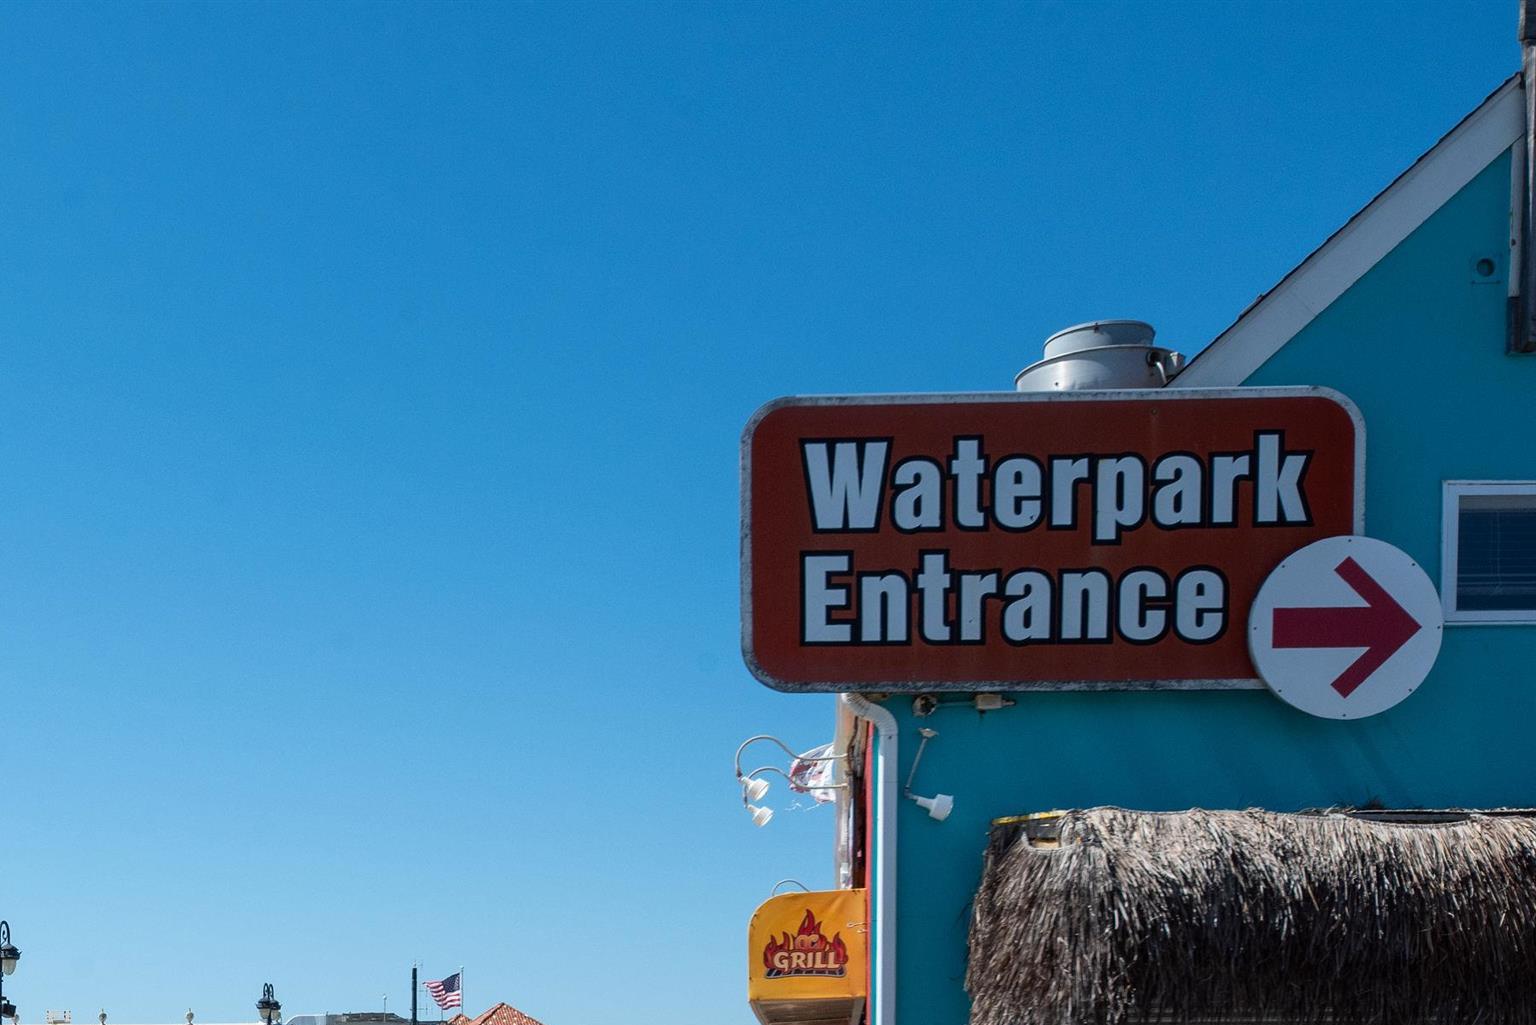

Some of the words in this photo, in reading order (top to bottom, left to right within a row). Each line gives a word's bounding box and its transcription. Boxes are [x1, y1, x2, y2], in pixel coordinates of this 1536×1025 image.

[801, 430, 1314, 545] Waterpark
[801, 550, 1229, 646] Entrance
[773, 951, 841, 972] GRILL
